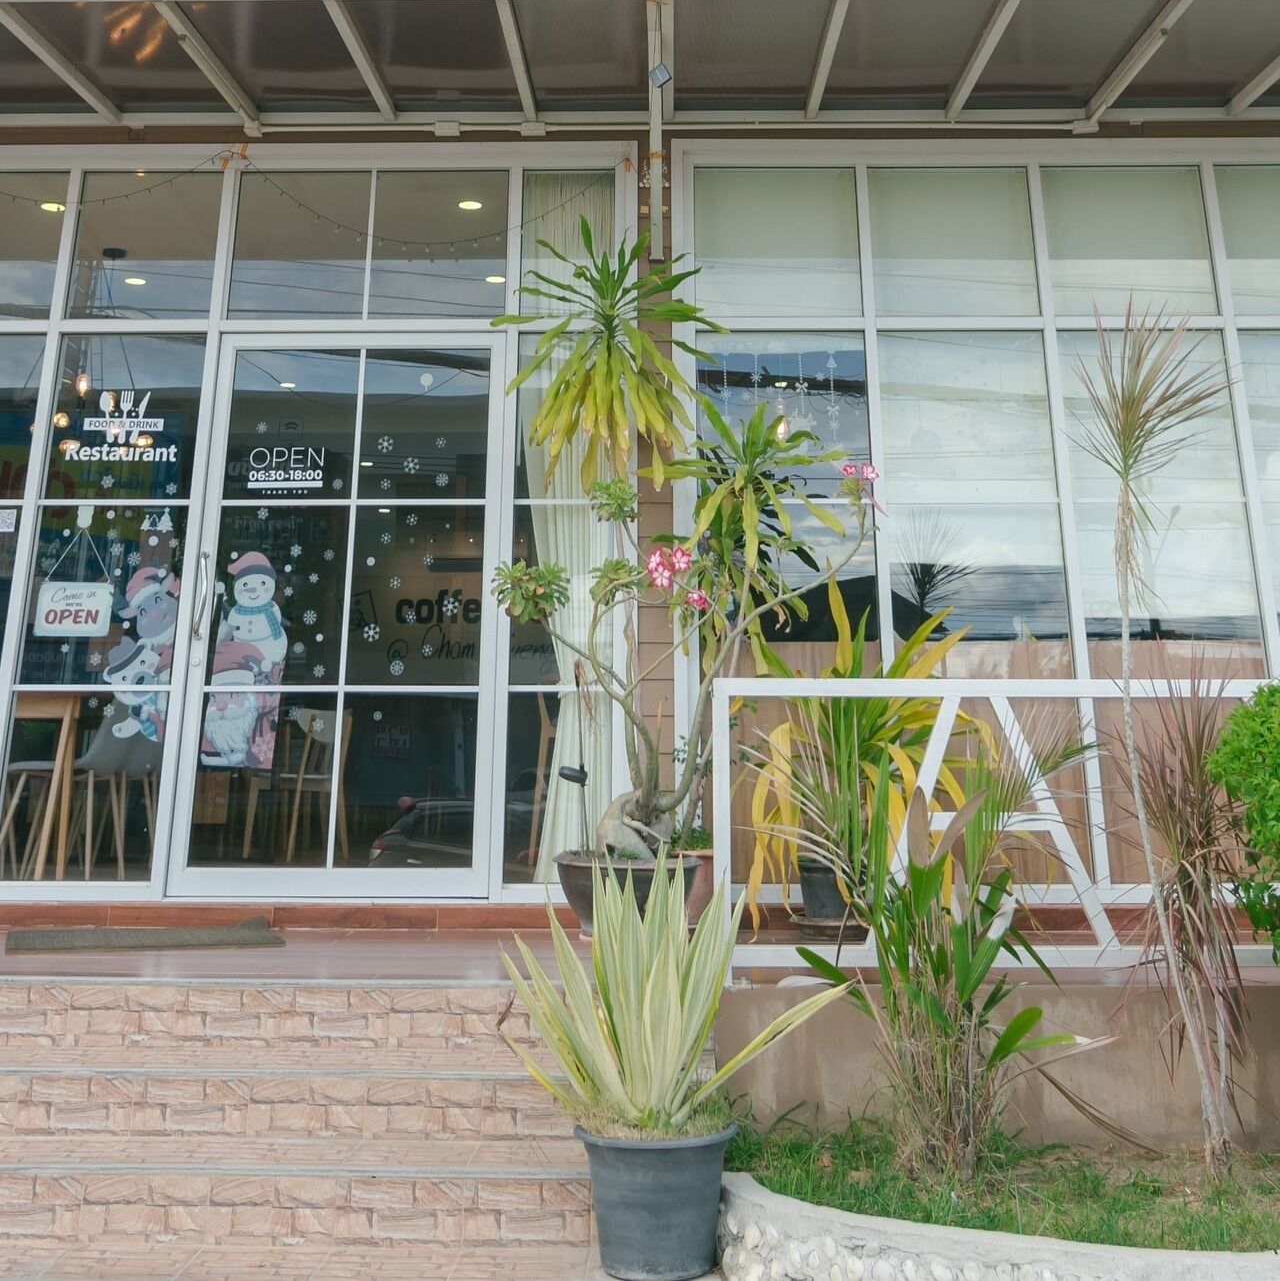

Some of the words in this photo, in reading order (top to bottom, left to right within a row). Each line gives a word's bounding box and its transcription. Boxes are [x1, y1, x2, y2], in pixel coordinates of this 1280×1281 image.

[89, 420, 115, 429] FOOD
[129, 420, 159, 429] DRINK
[64, 442, 178, 462] Restaurant
[249, 447, 325, 469] OPEN
[248, 469, 323, 481] 06:30-18:00
[51, 587, 83, 603] Come
[395, 589, 481, 624] coffe
[44, 609, 100, 625] OPEN
